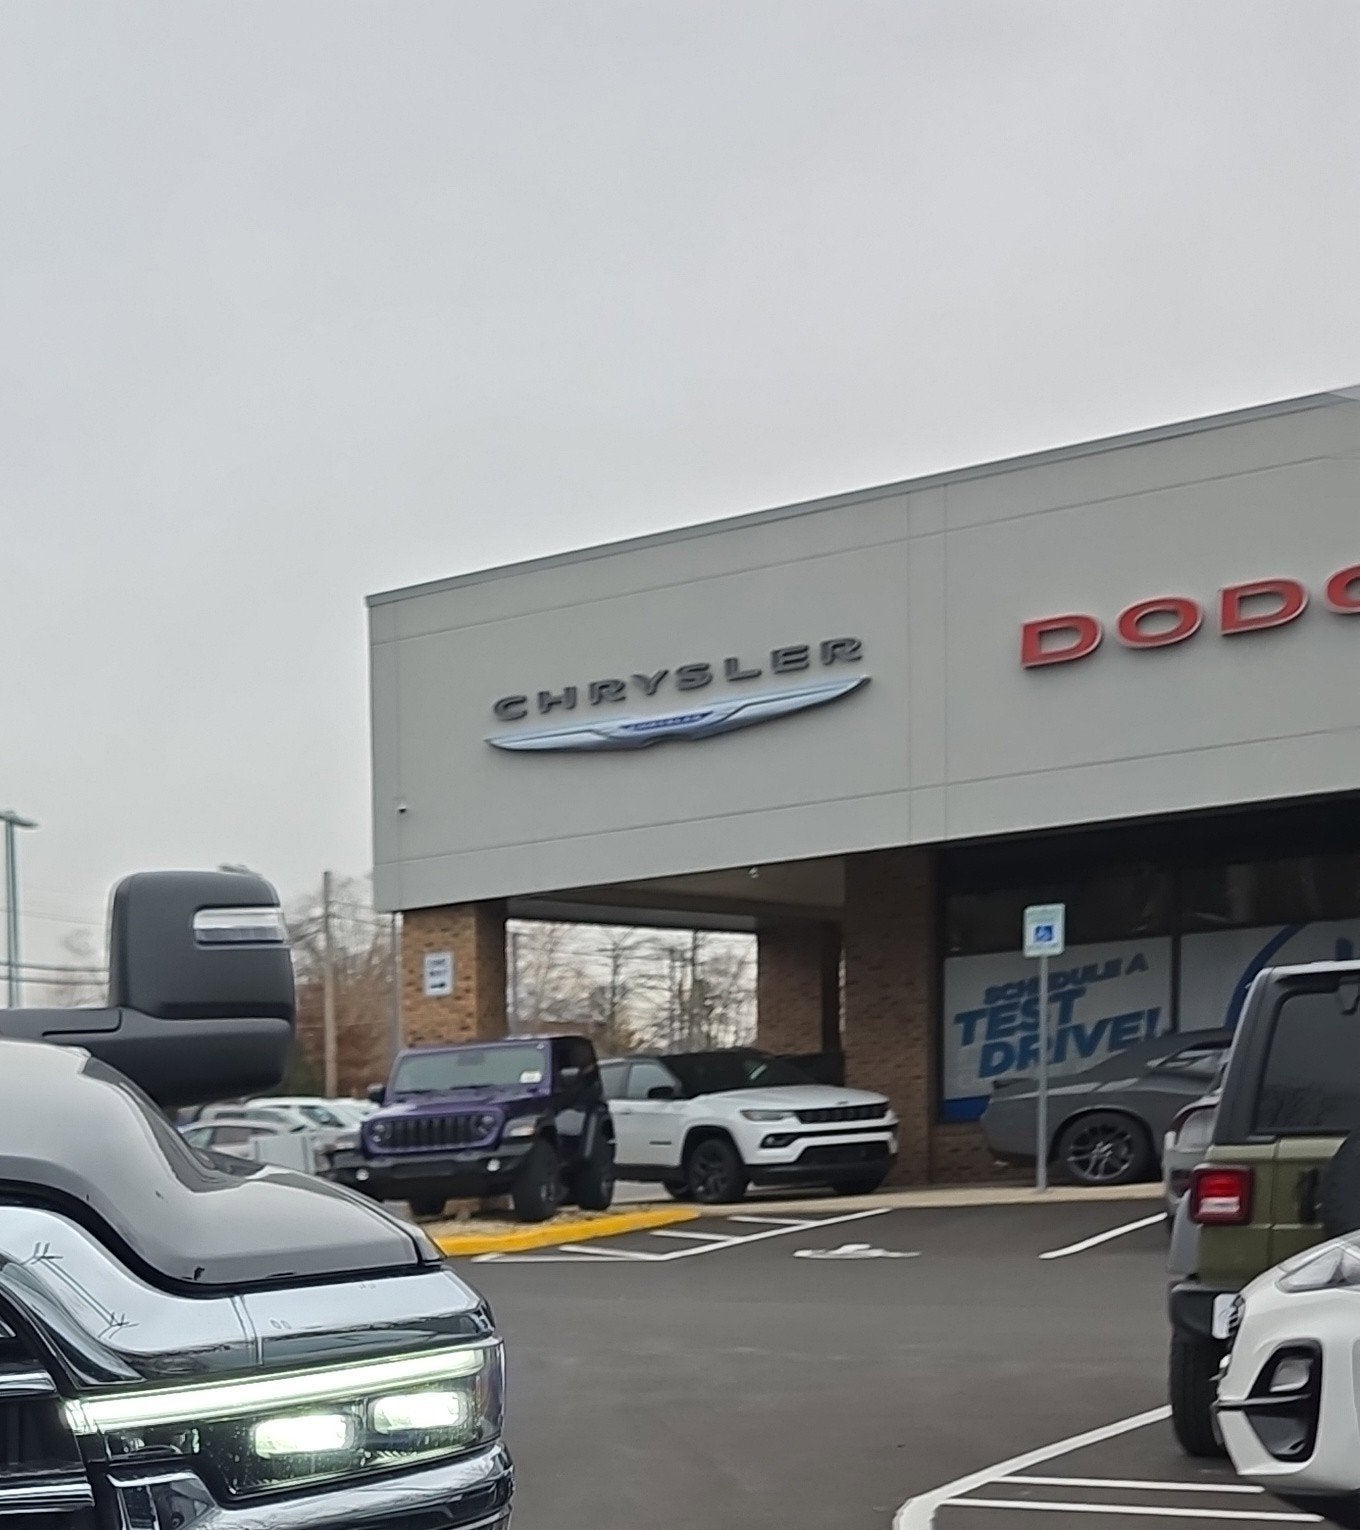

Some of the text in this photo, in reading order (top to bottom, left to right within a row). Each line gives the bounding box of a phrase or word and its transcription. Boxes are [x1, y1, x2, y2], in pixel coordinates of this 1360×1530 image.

[493, 636, 863, 722] CHRYSLER
[984, 952, 1149, 1005] SCHDULE A
[954, 986, 1087, 1047] TEST
[978, 1006, 1163, 1079] DRIVE!
